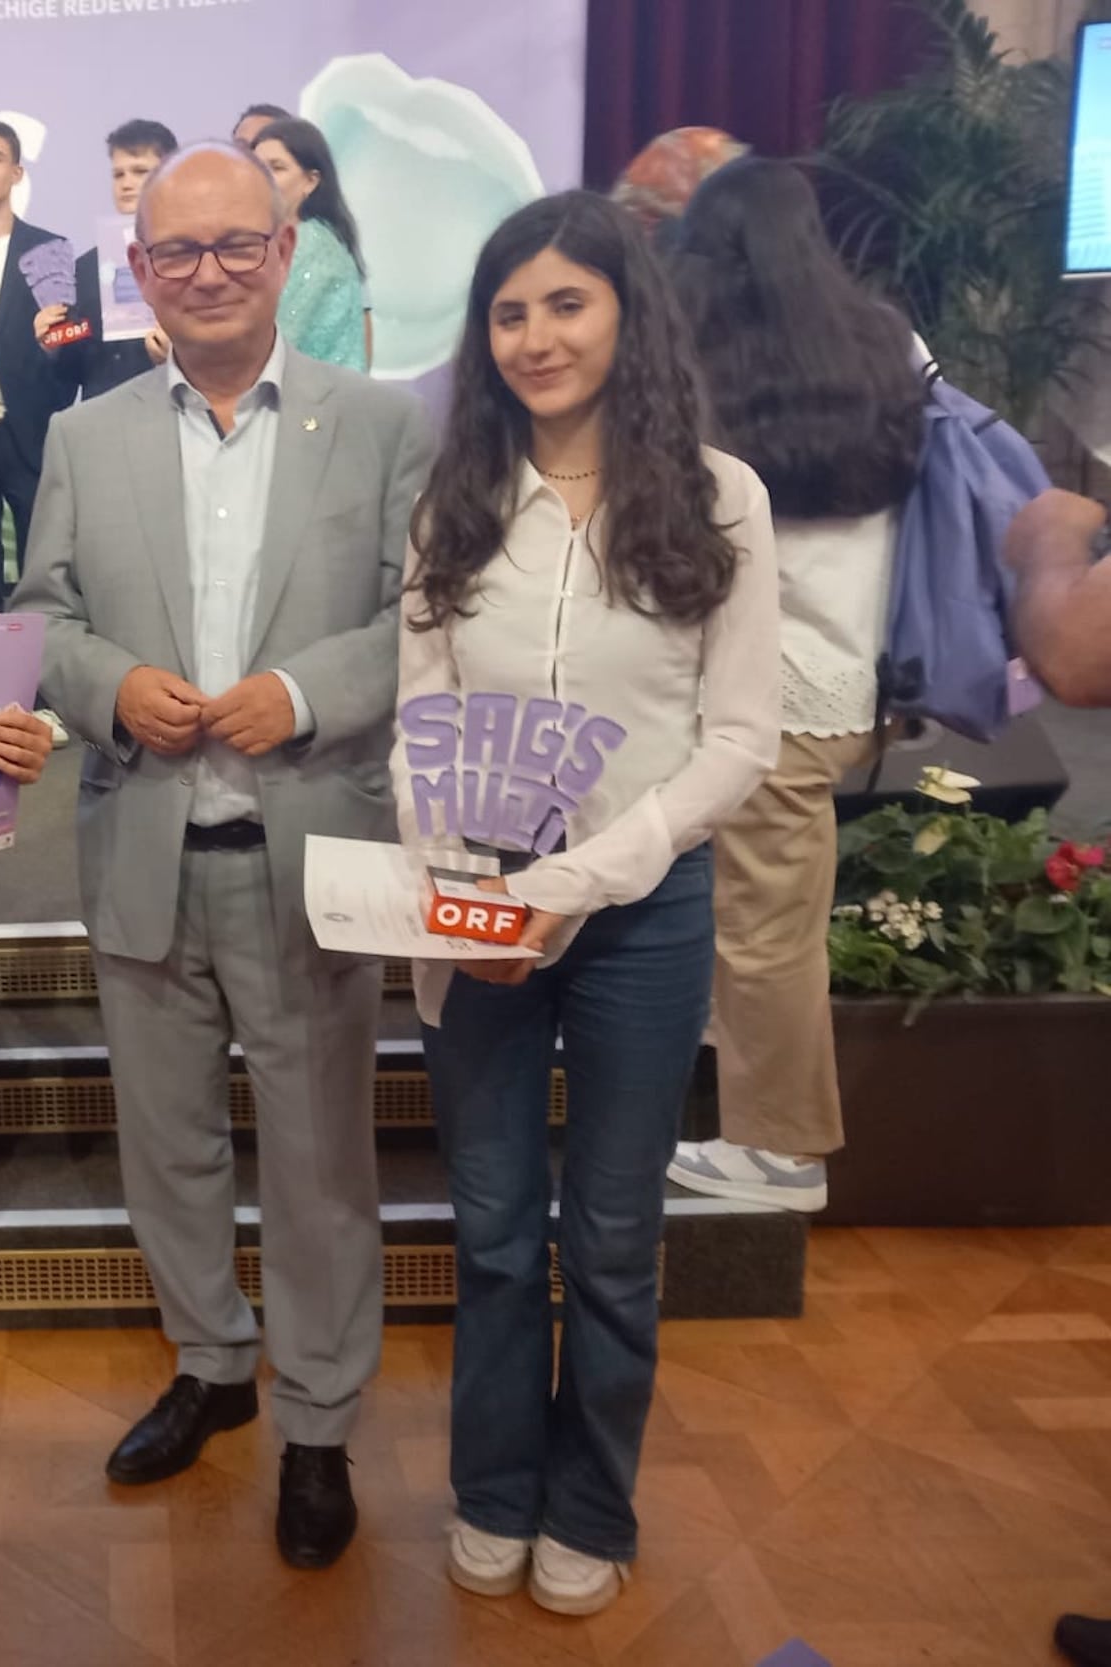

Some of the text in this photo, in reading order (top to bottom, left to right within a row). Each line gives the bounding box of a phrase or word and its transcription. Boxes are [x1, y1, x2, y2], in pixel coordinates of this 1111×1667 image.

[399, 692, 627, 797] SAG'S
[410, 769, 579, 857] MULTI
[436, 903, 517, 934] ORF
